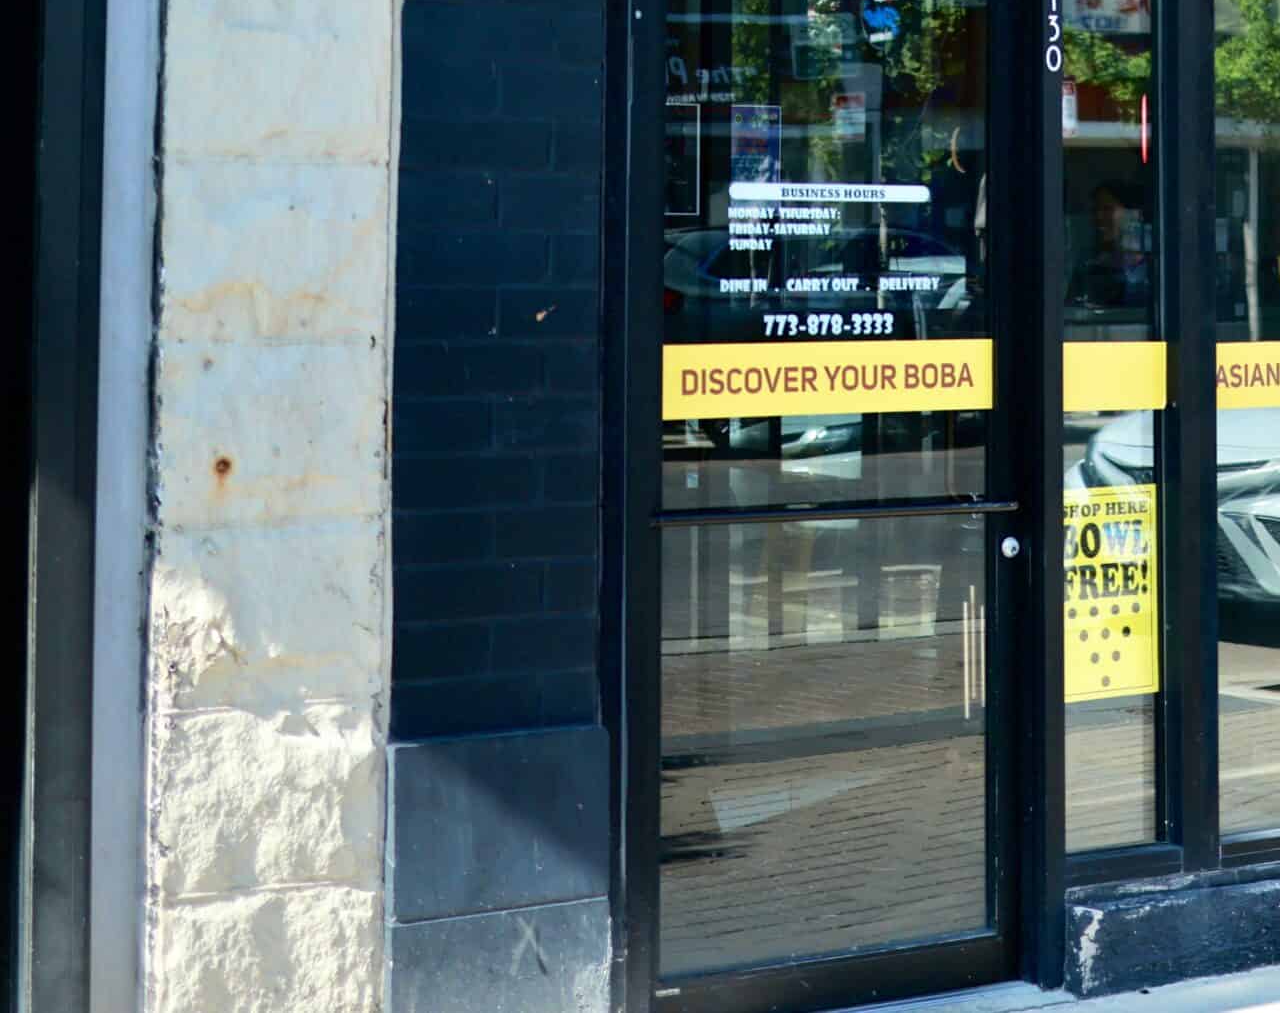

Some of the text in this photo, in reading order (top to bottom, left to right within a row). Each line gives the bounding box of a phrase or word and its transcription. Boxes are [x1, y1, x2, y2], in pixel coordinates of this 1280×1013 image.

[781, 187, 887, 200] BUSINESS HOURS
[729, 239, 773, 251] SUNDAY
[719, 276, 941, 293] DINE IN CARRY OUT DELIVERY
[762, 313, 894, 337] 773-878-3333
[680, 361, 974, 397] DISCOVER YOUR BOBA
[1216, 362, 1280, 388] ASIAN
[1105, 500, 1148, 516] HERE
[1063, 519, 1149, 560] BOWL
[1063, 558, 1148, 602] FREE!
